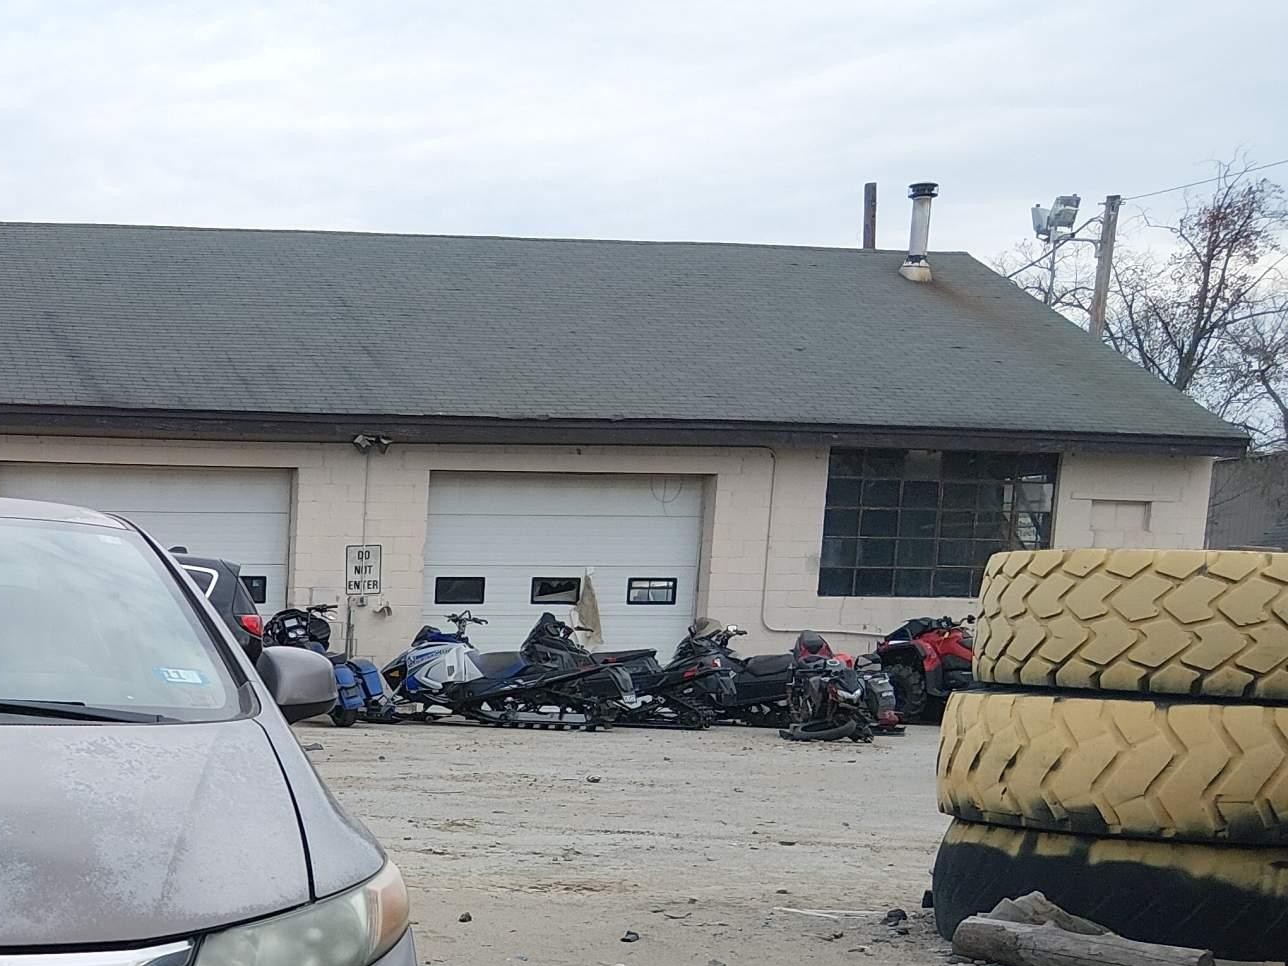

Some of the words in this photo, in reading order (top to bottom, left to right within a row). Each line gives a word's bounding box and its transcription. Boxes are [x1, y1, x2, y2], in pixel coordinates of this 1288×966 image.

[357, 550, 371, 560] DO
[354, 565, 374, 575] NOT
[348, 580, 379, 590] ENTER
